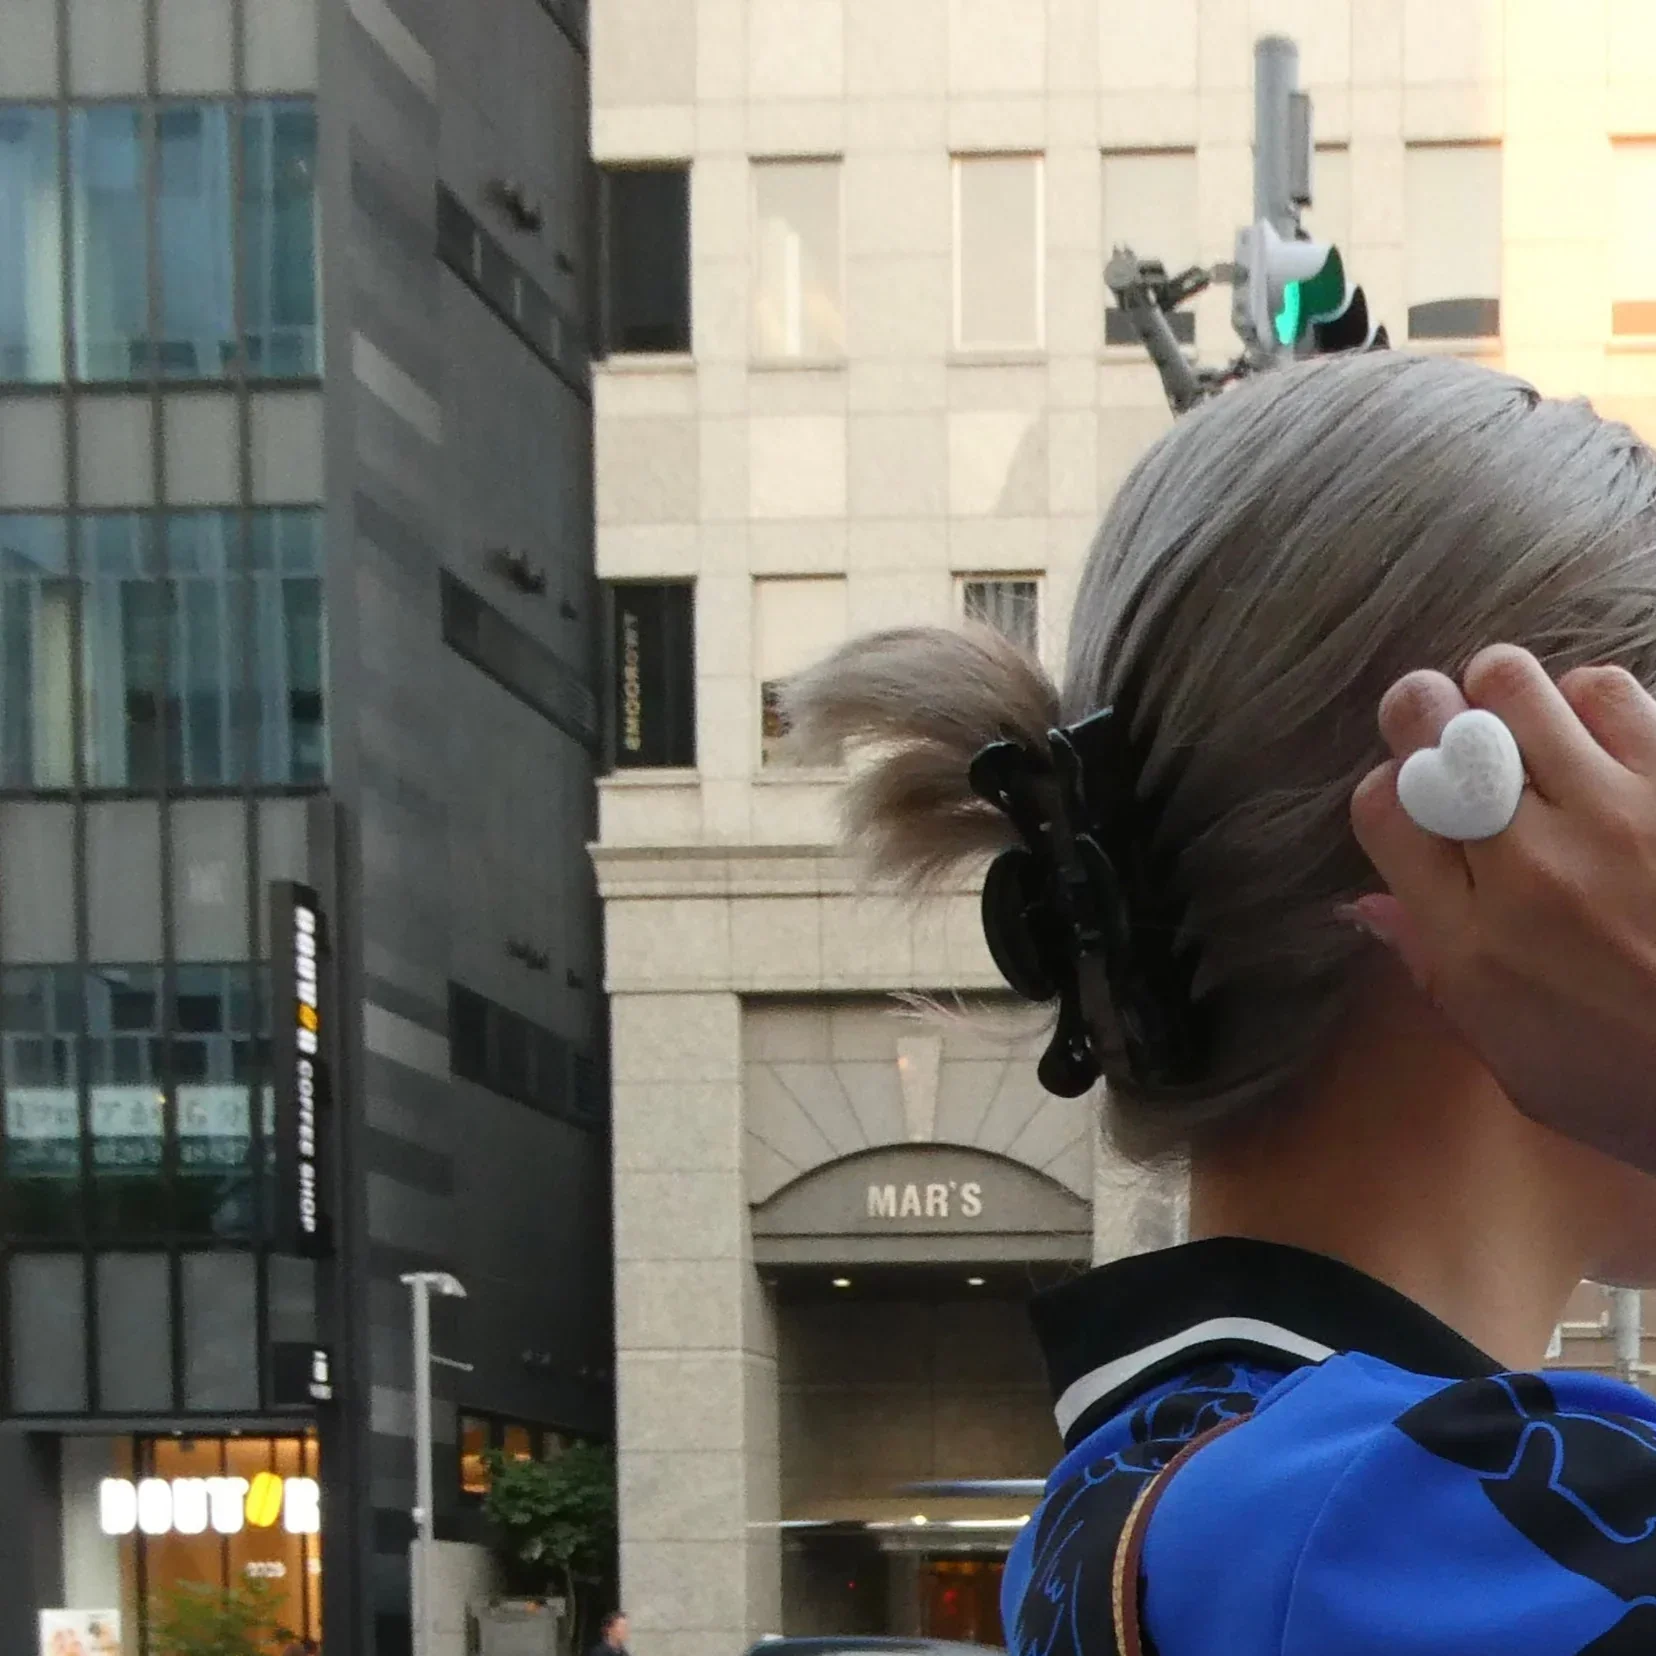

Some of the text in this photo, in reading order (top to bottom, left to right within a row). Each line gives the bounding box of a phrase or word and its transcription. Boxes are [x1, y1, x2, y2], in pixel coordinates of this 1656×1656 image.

[299, 1058, 315, 1158] COFFEE
[300, 1162, 316, 1233] SHOP
[867, 1181, 983, 1218] MAR'S
[99, 1471, 321, 1535] DOUTOR
